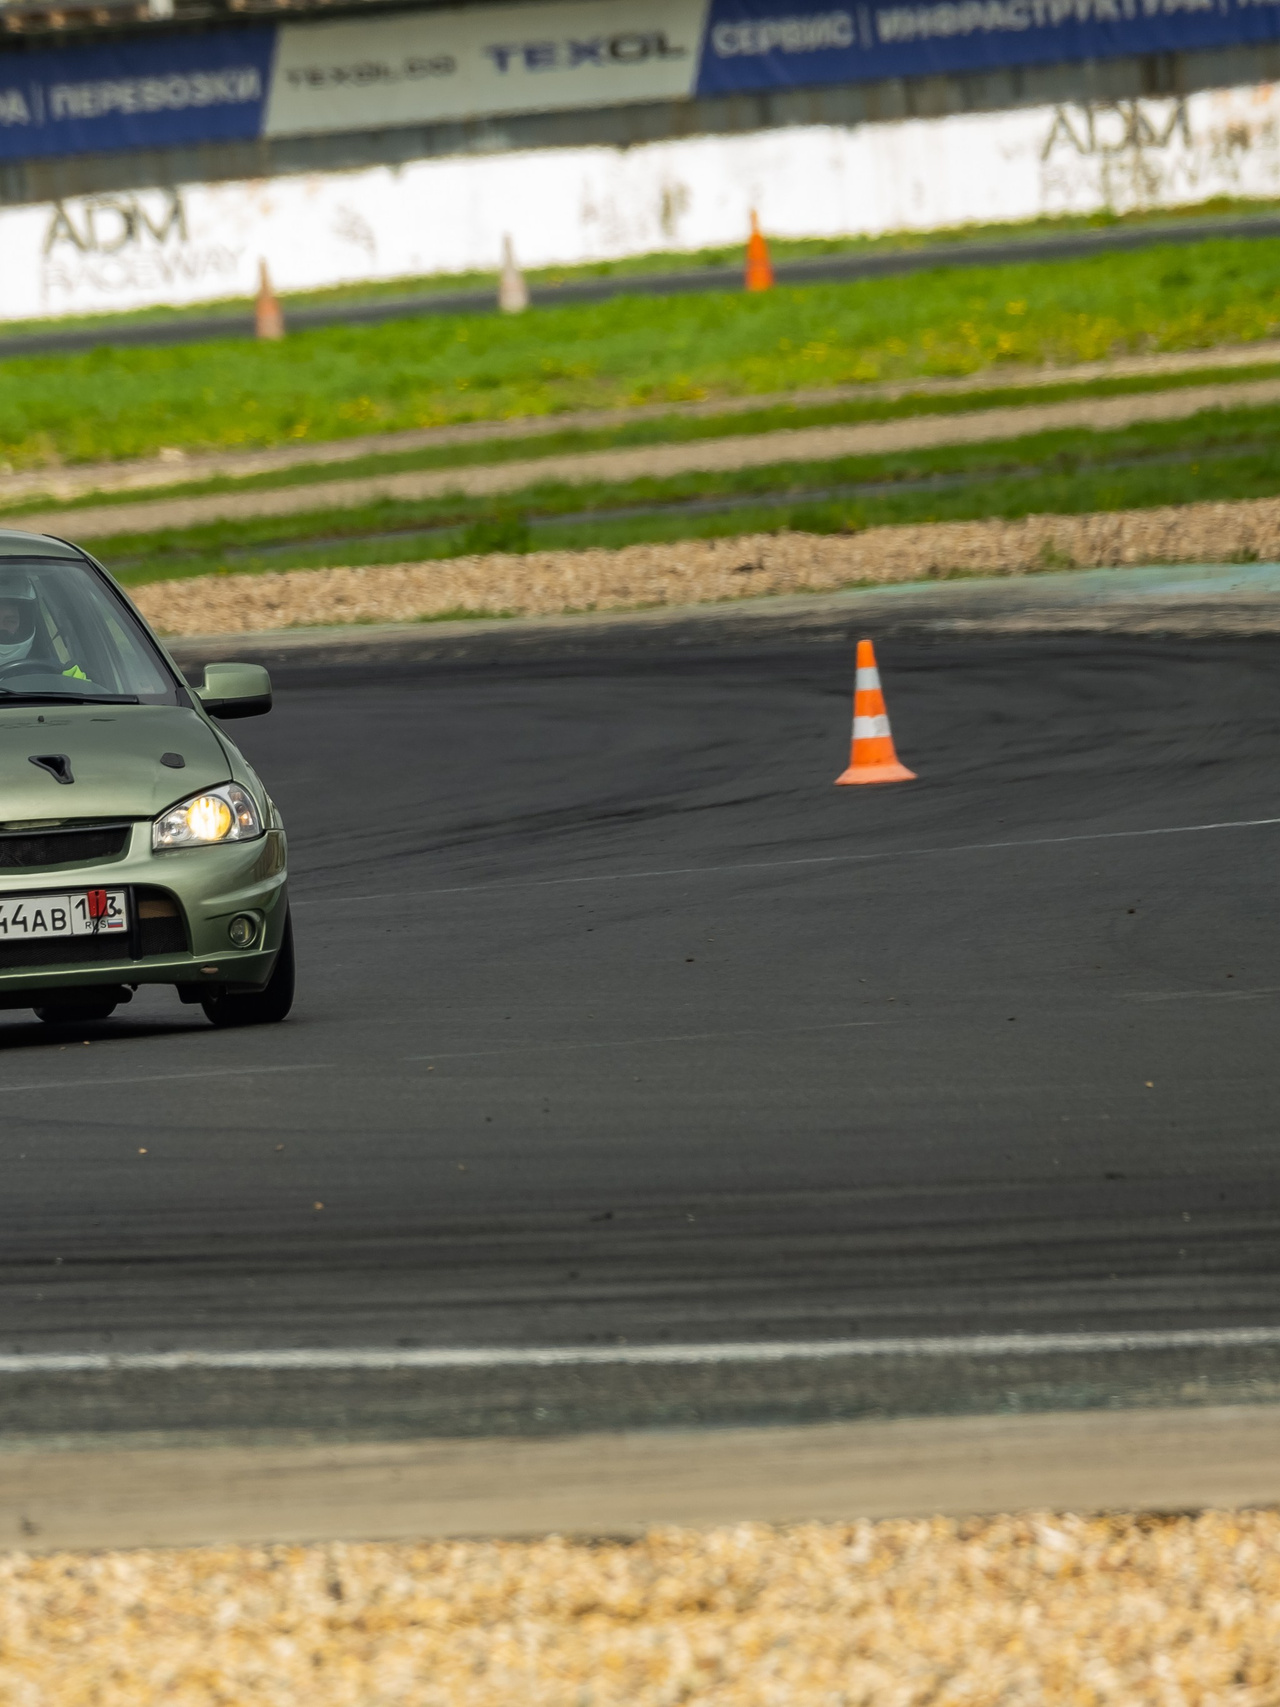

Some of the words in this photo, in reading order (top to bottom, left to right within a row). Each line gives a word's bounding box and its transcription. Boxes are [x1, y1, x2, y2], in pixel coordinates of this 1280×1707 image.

[483, 30, 686, 74] TEXOL
[51, 67, 261, 121] ПЕРЕВОЗКИ
[1041, 97, 1193, 160] ADM
[43, 192, 189, 258] ADM
[75, 896, 117, 920] 13
